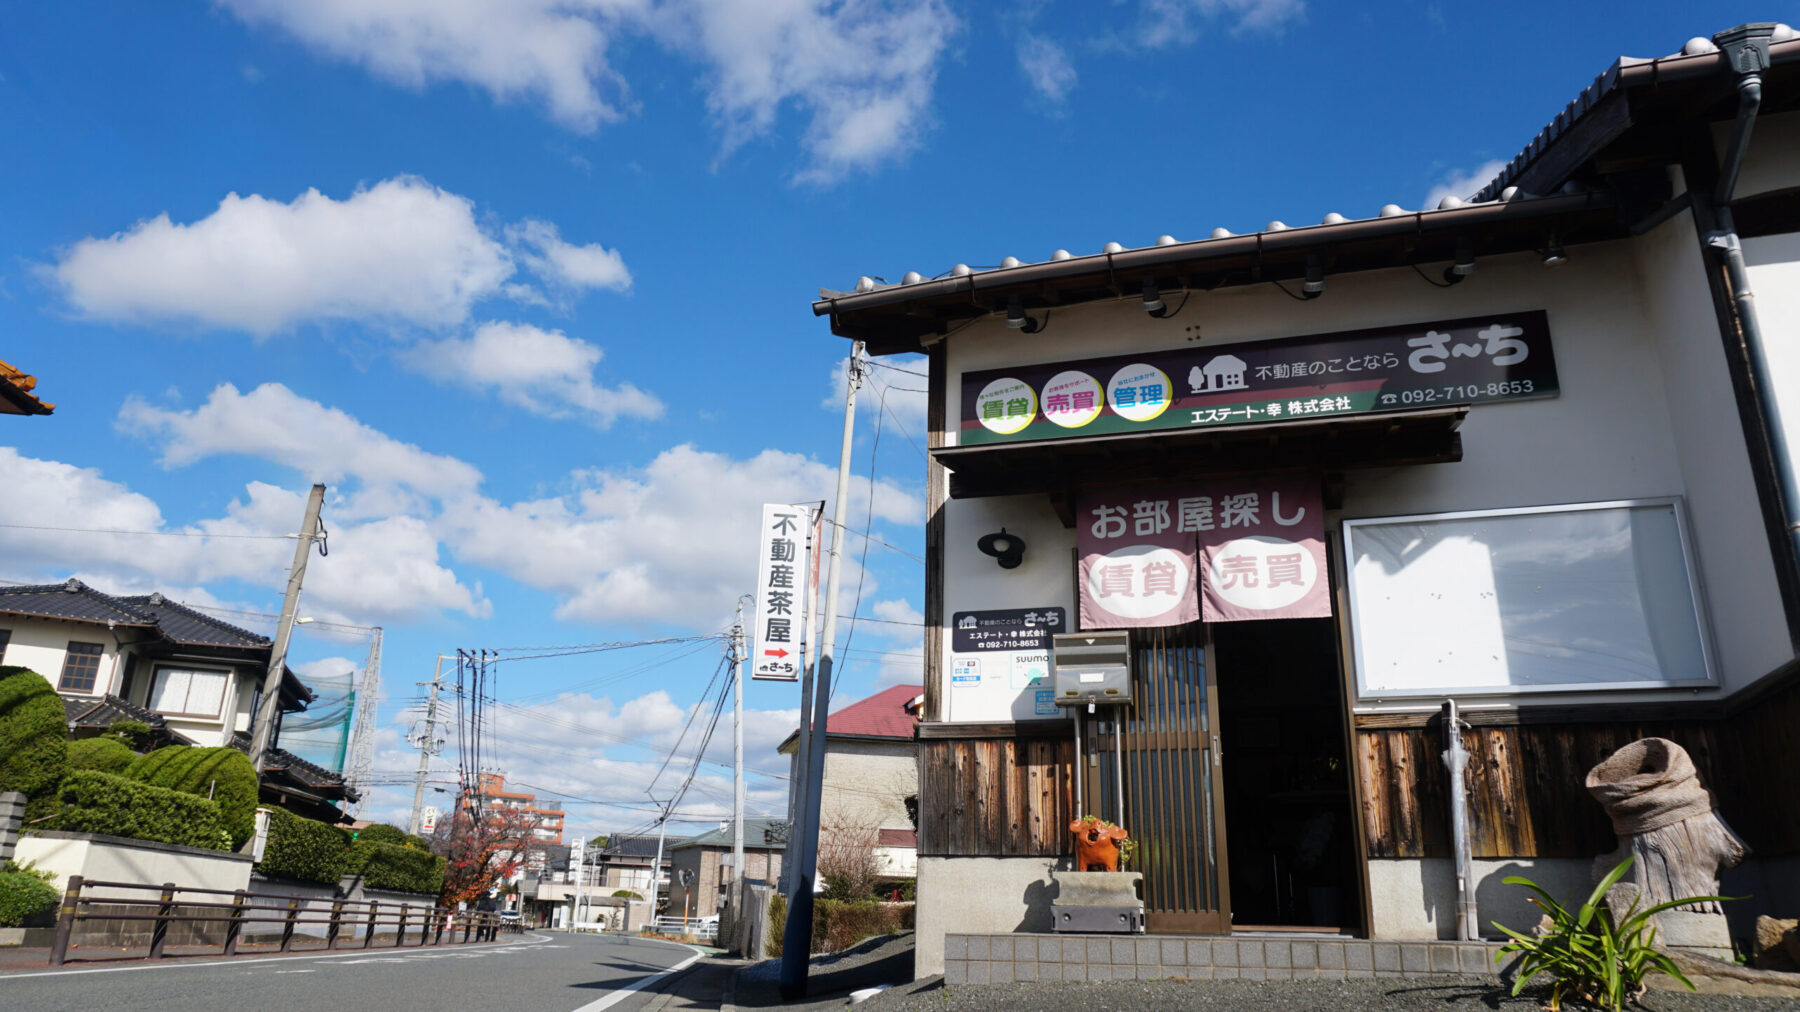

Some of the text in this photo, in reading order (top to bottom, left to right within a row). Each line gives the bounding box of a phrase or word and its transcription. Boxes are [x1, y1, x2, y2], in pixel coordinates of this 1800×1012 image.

[1255, 352, 1400, 381] 不動産のことなら
[1047, 391, 1095, 416] 売買
[1114, 384, 1164, 409] 管理
[1401, 379, 1534, 404] 092-710-8653
[982, 397, 1029, 422] 賃貸
[1191, 396, 1352, 424] エステート・幸 株式会社
[1091, 491, 1305, 539] お部屋探し
[765, 513, 797, 643] 不動産茶屋
[1098, 560, 1178, 599] 賃貸
[1221, 553, 1305, 590] 売買
[986, 640, 1039, 649] 092-710-8653
